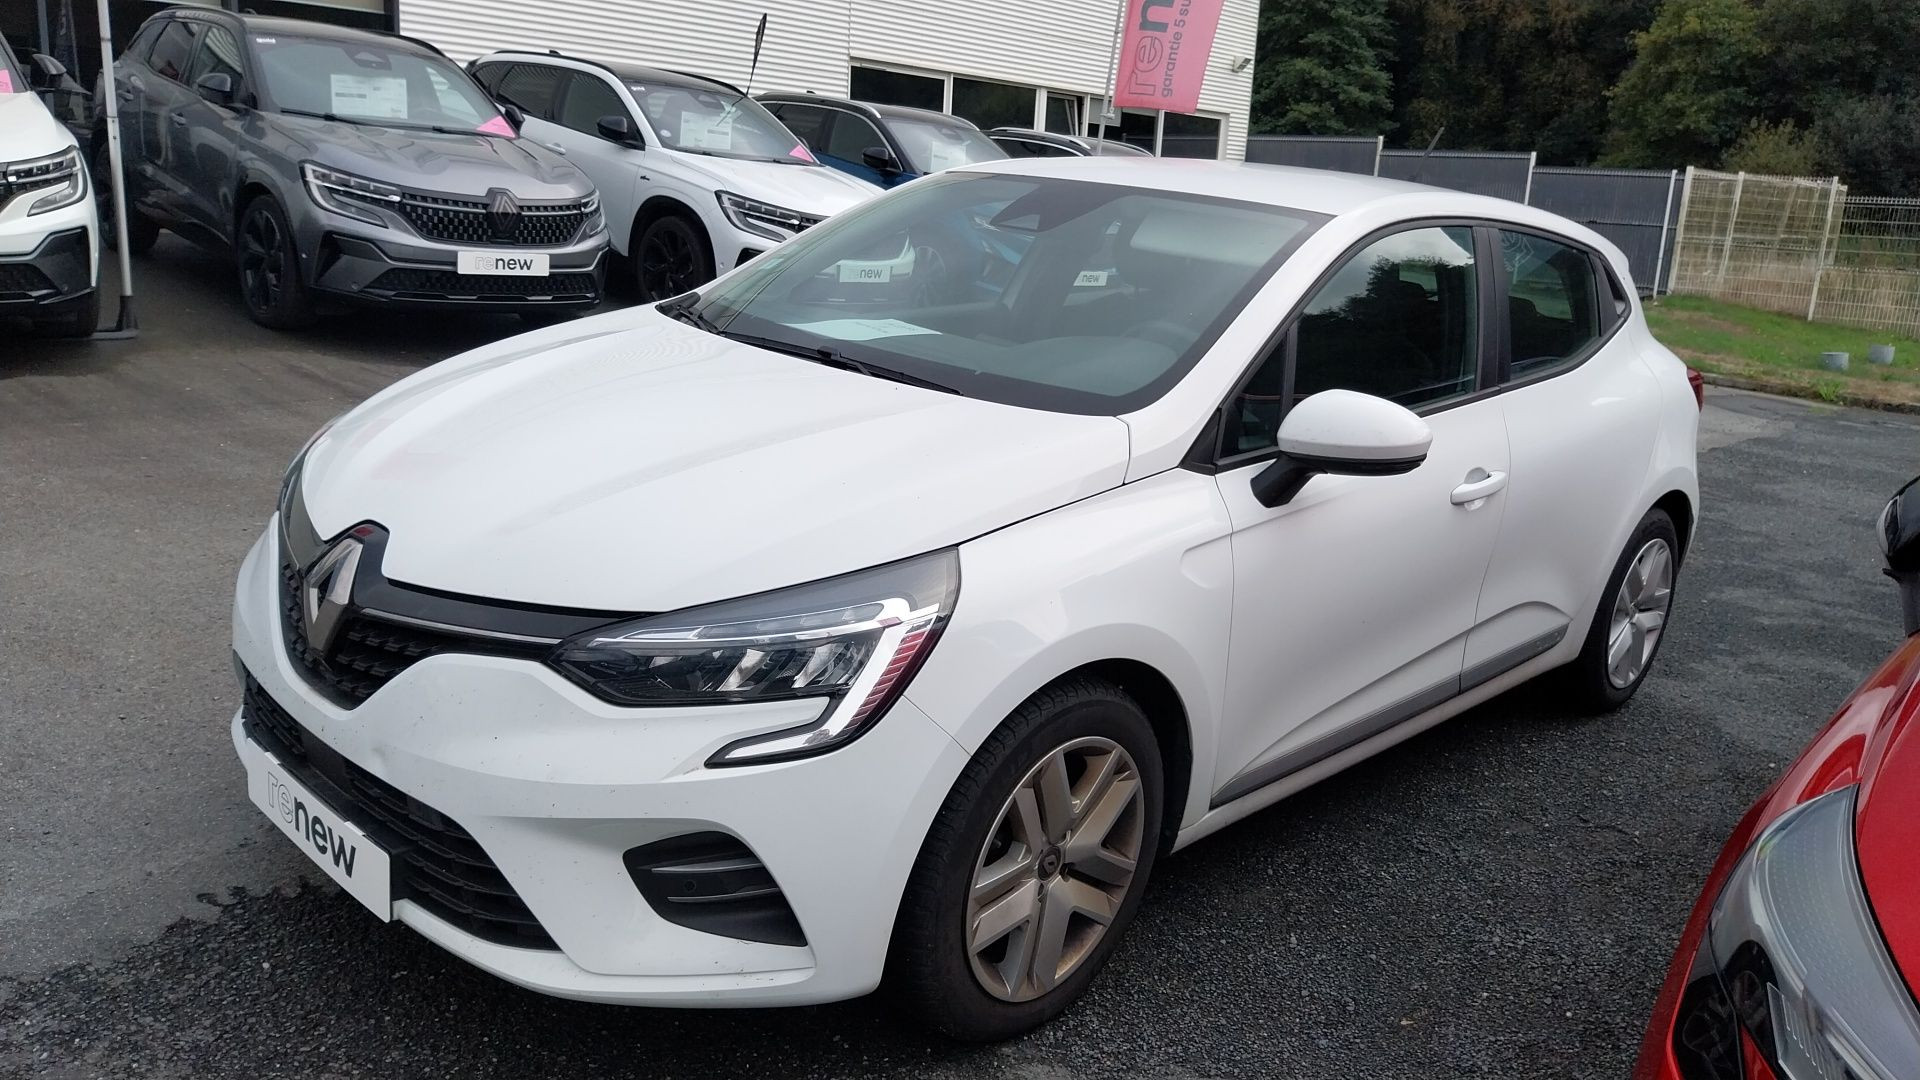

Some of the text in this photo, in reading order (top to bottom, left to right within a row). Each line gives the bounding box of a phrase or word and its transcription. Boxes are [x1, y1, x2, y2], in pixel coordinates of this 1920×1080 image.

[1161, 31, 1183, 98] garantie
[1173, 19, 1186, 28] 5
[474, 256, 533, 271] renew
[267, 771, 357, 879] renew
